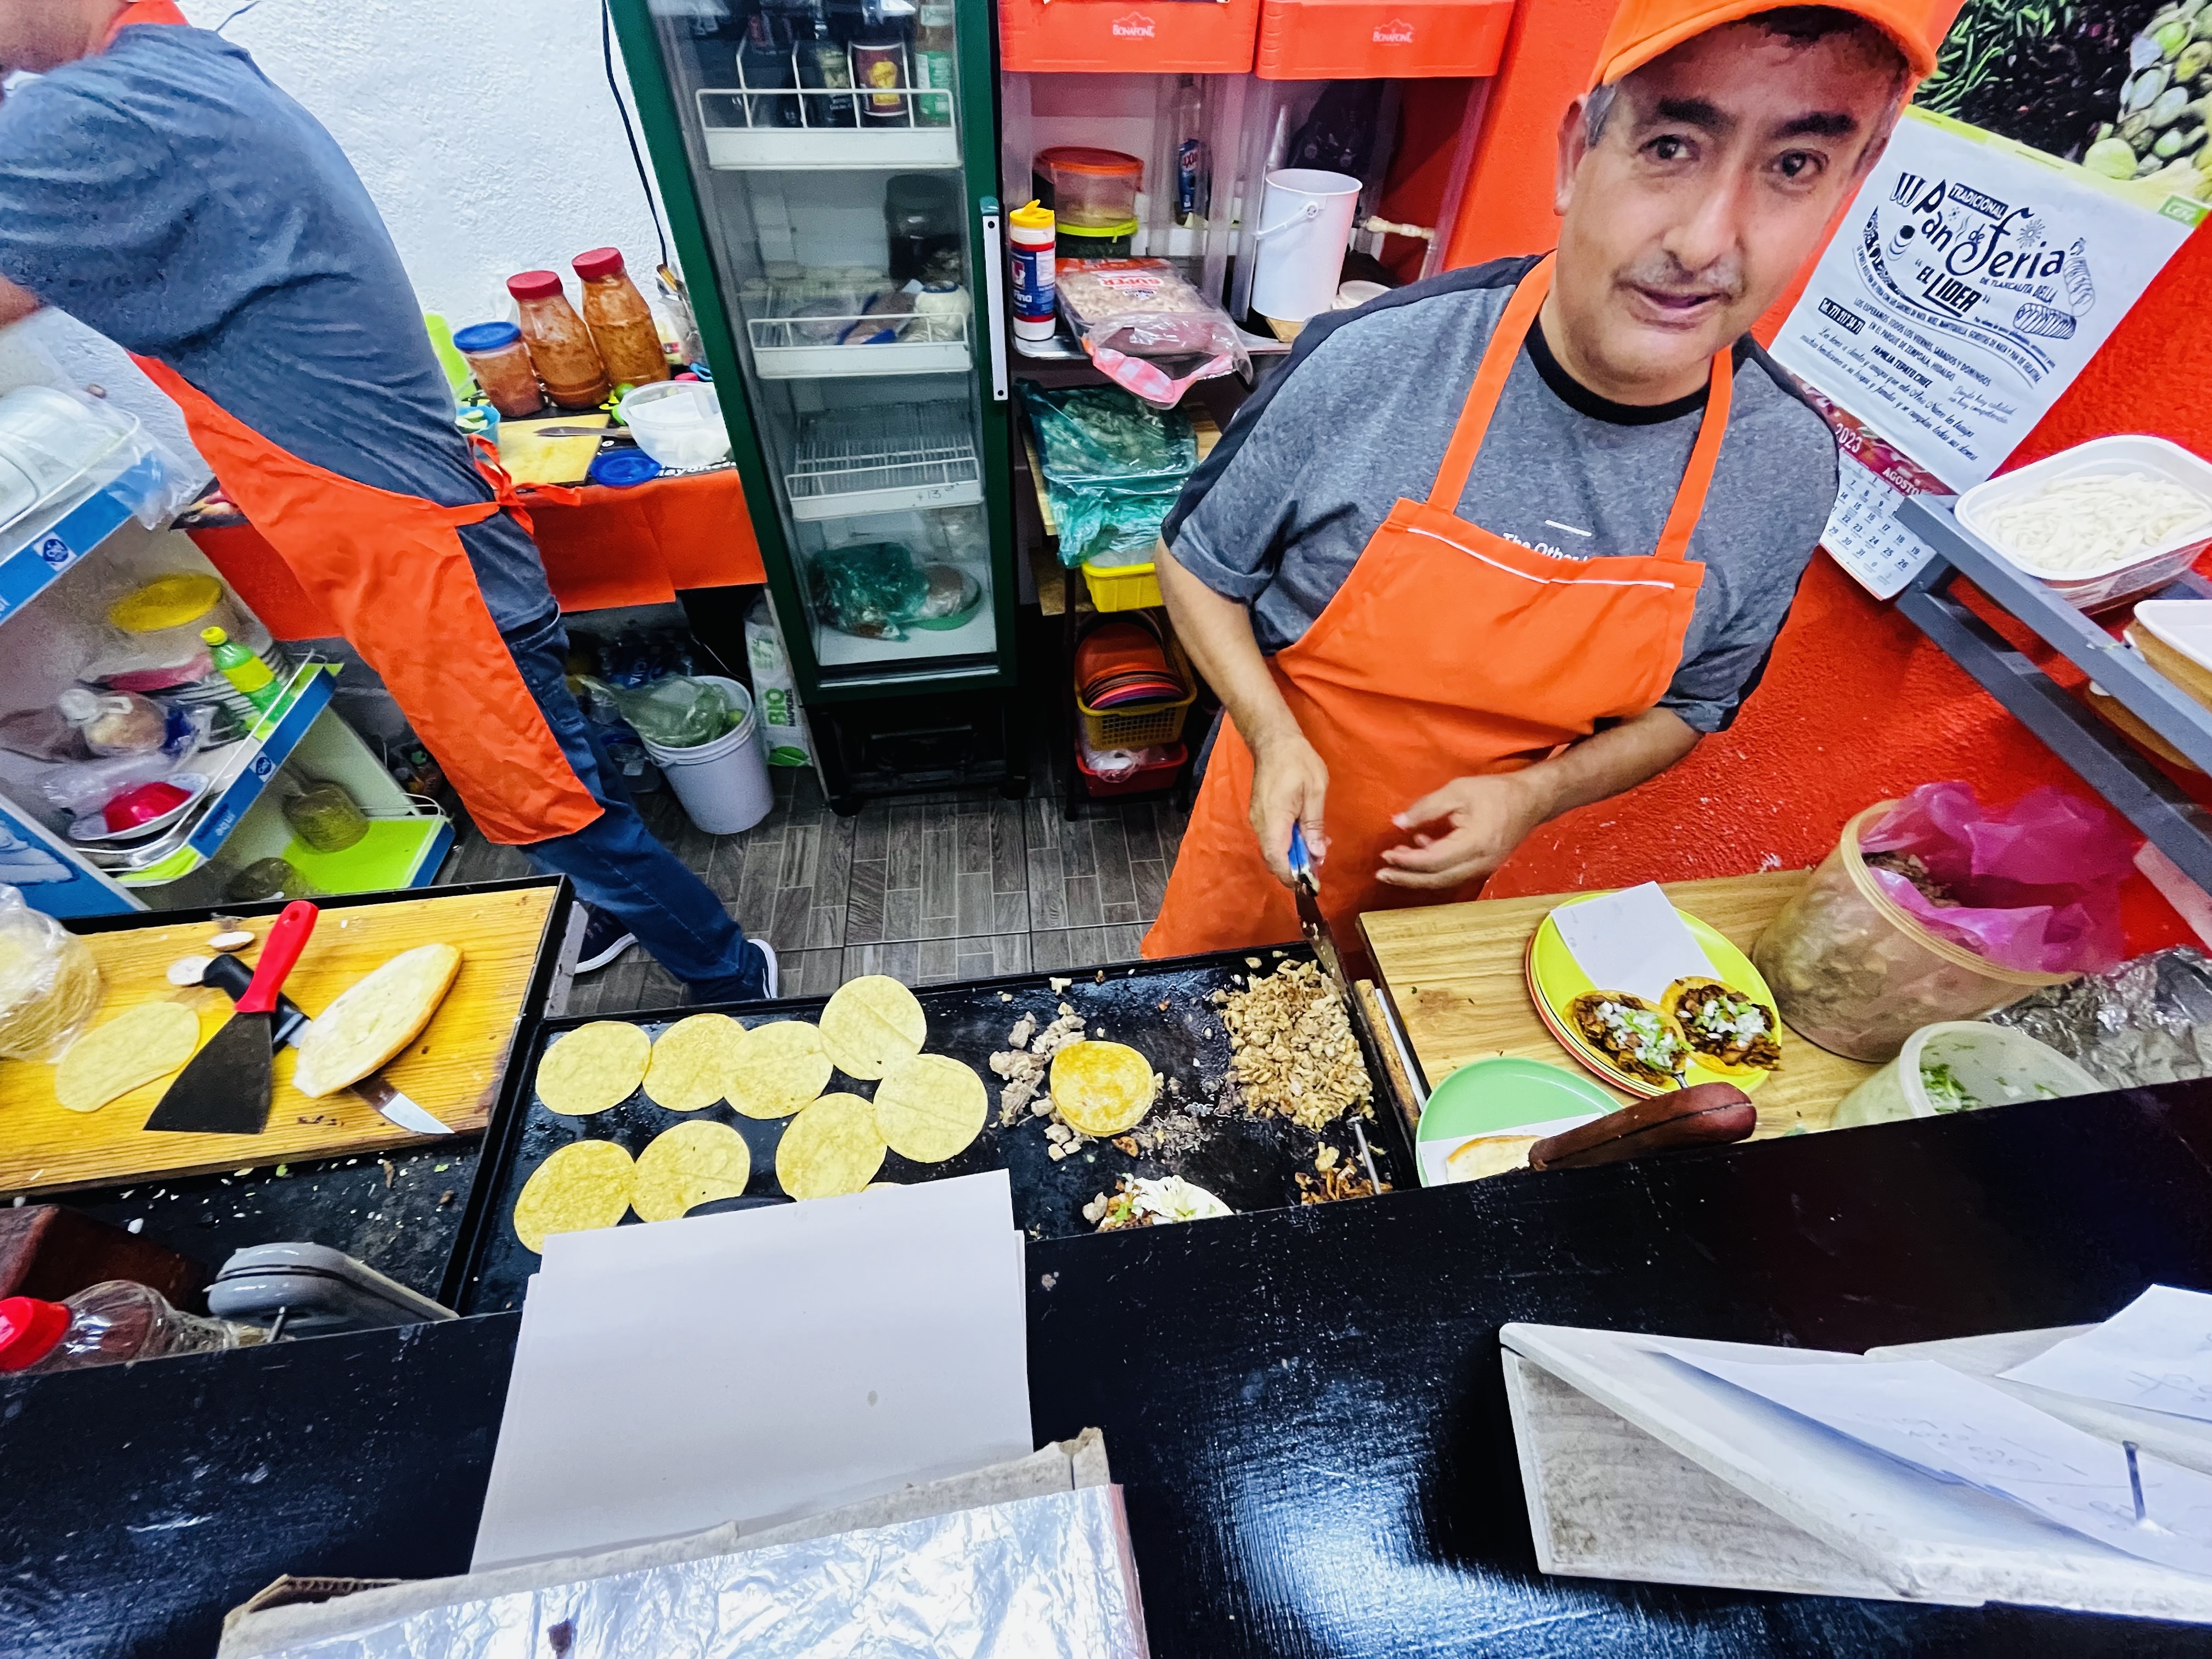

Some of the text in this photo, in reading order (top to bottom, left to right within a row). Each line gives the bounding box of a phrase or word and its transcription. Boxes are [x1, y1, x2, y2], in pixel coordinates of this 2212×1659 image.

[1912, 179, 1953, 252] Pan
[1968, 223, 1985, 244] de
[1949, 184, 2007, 219] TRADICIONAL
[2032, 285, 2058, 304] BELLA
[1827, 305, 1841, 319] 771
[1852, 320, 1864, 334] 71
[1868, 321, 1877, 330] EN
[1874, 325, 1883, 334] EL
[1880, 329, 1901, 346] PARQUE
[1898, 340, 1908, 350] DE
[1854, 297, 1864, 308] LOS
[1863, 302, 1890, 323] ESPERAMOS
[1888, 319, 1905, 333] TODOS
[1903, 328, 1915, 338] LOS
[1960, 363, 1992, 387] DOMINGOS
[1870, 345, 1895, 364] FAMILIA
[1835, 422, 1863, 453] 2023
[1882, 467, 1922, 495] AGOSTO
[1840, 492, 1921, 555] 14 15 16 17 18 19
[1829, 526, 1866, 556] 29 30 31
[1842, 514, 1852, 523] 22
[1853, 523, 1863, 532] 23
[1869, 535, 1880, 545] 24
[1883, 547, 1893, 557] 25
[1898, 558, 1909, 568] 26
[765, 688, 787, 726] BIO
[785, 688, 796, 727] NAPKINS
